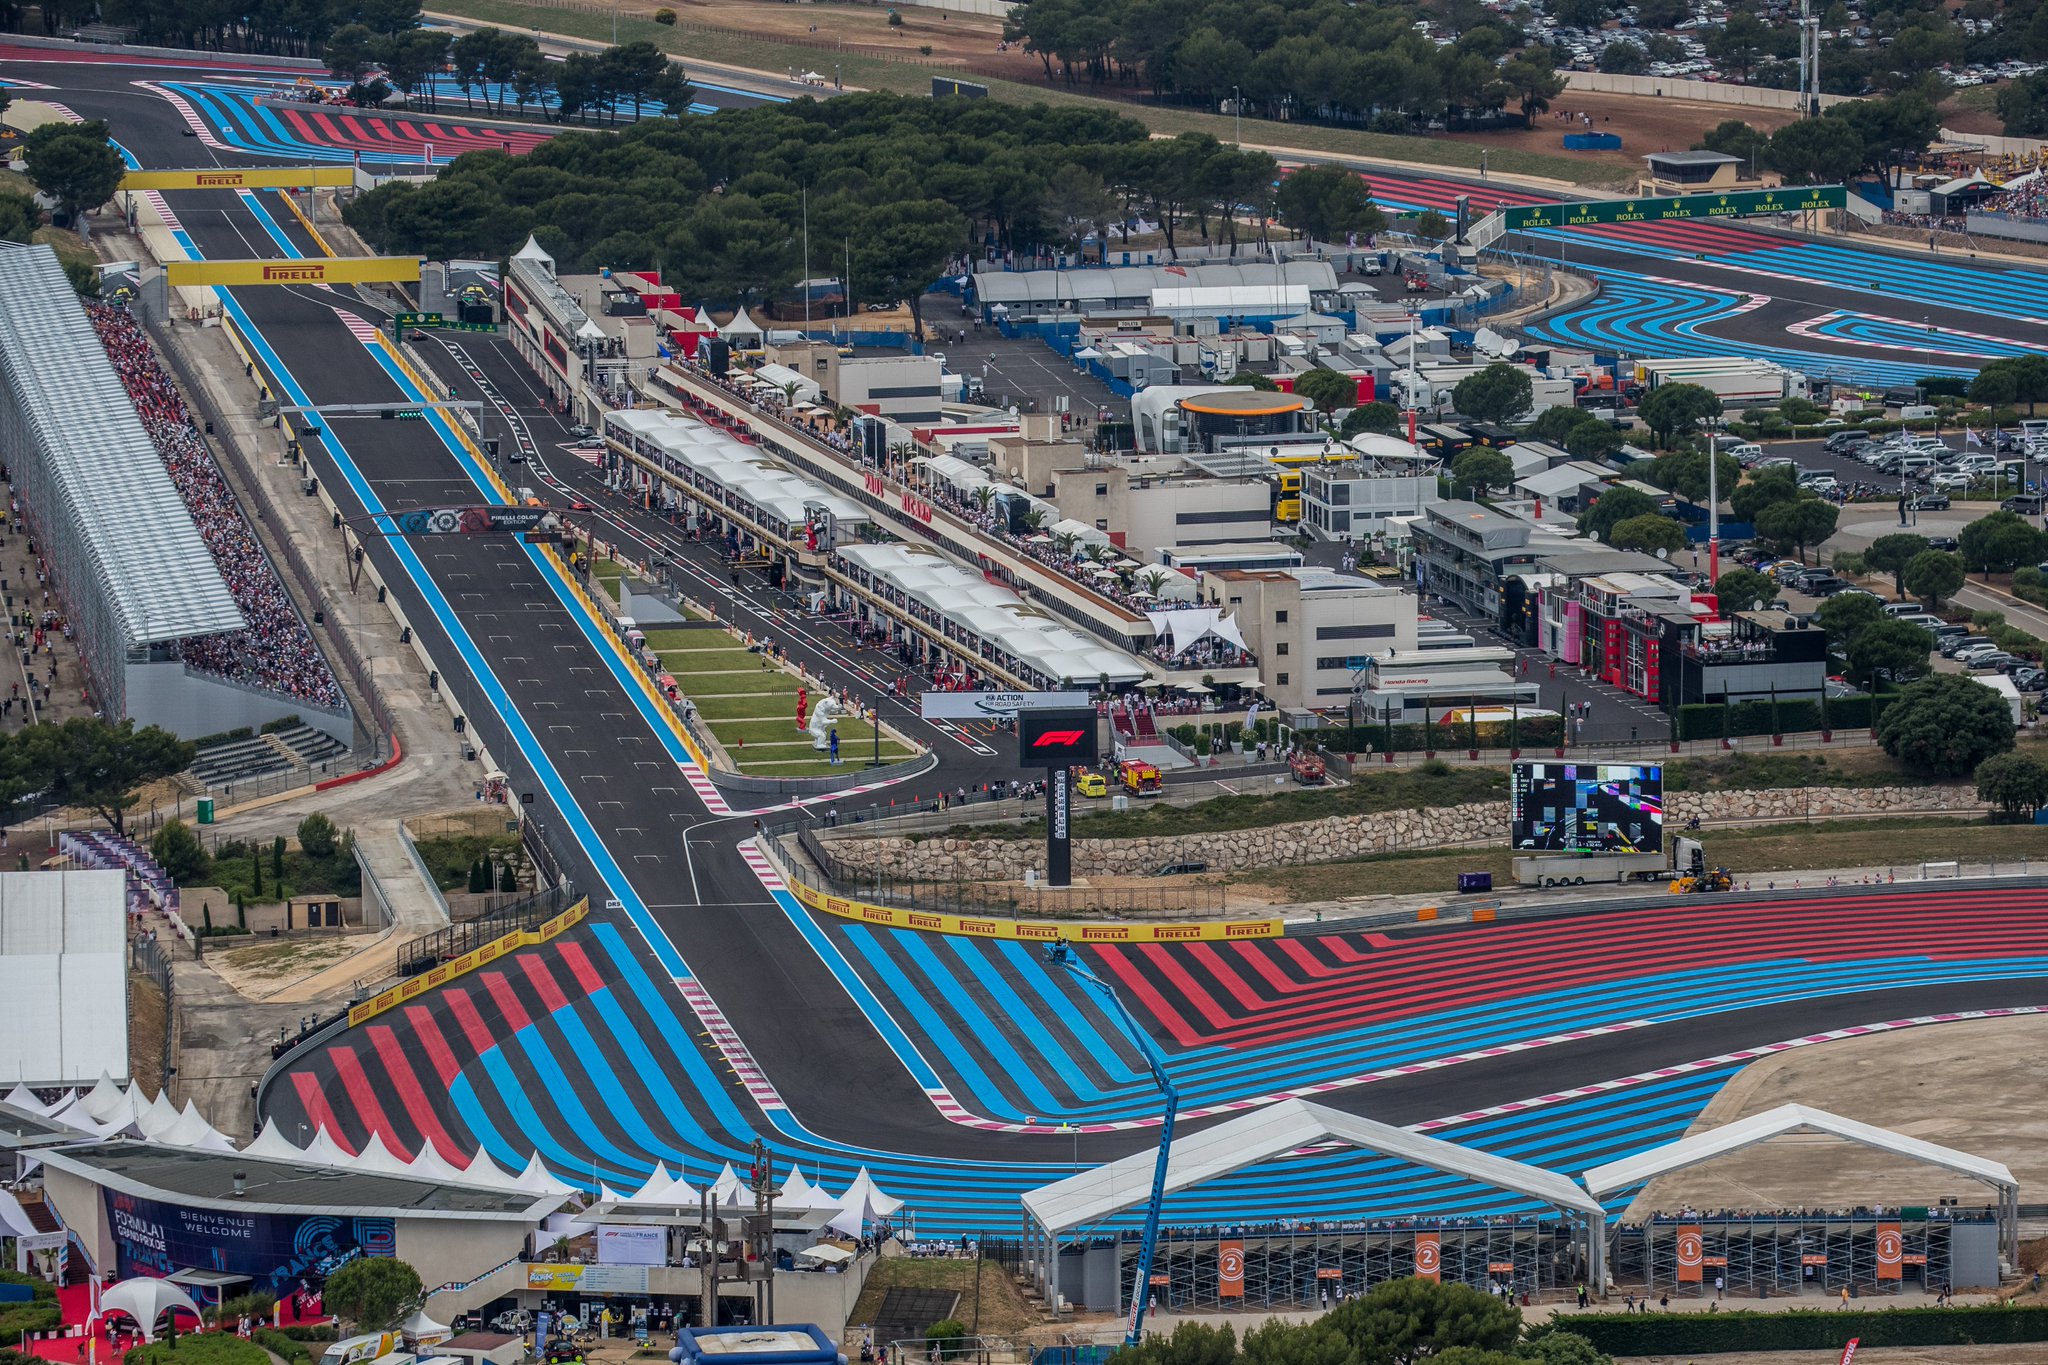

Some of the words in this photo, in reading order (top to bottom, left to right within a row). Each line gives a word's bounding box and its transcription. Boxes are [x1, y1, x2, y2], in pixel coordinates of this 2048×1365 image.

[197, 174, 242, 185] PIRELLI
[1709, 206, 1737, 215] ROLEX
[1755, 203, 1783, 211] ROLEX
[1801, 200, 1829, 208] ROLEX
[1569, 215, 1598, 224] ROLEX
[1616, 212, 1644, 221] ROLEX
[1663, 210, 1691, 218] ROLEX
[1523, 218, 1551, 227] ROLEX
[263, 265, 324, 280] PIRELLI
[864, 472, 884, 498] PAUL
[901, 492, 932, 524] RICARD
[804, 888, 818, 904] PIRELLI
[826, 898, 850, 914] PIRELLI
[563, 909, 575, 926] PIRELLI
[863, 907, 892, 922] PIRELLI
[908, 914, 941, 929] PIRELLI
[543, 921, 558, 938] PIRELLI
[959, 920, 995, 934] PIRELLI
[1016, 925, 1058, 938] PIRELLI
[1082, 927, 1128, 939] PIRELLI
[1153, 926, 1200, 938] PIRELLI
[1226, 923, 1270, 936] PIRELLI
[503, 933, 519, 950] PIRELLI
[479, 945, 496, 963] PIRELLI
[454, 956, 472, 973] PIRELLI
[428, 968, 447, 985] PIRELLI
[402, 979, 420, 997] PIRELLI
[376, 992, 394, 1010] PIRELLI
[353, 1004, 370, 1022] PIRELLI
[115, 1209, 159, 1238] FORMULA
[180, 1211, 255, 1228] BIENVENUE
[184, 1222, 251, 1238] WELCOME
[117, 1225, 139, 1242] GRAND
[155, 1240, 166, 1251] DE
[1685, 1243, 1694, 1256] 1
[1885, 1240, 1894, 1253] 1
[1226, 1257, 1236, 1271] 2
[1422, 1250, 1433, 1263] 2
[1134, 1273, 1144, 1301] LOCATION
[1842, 1342, 1856, 1365] OTUL
